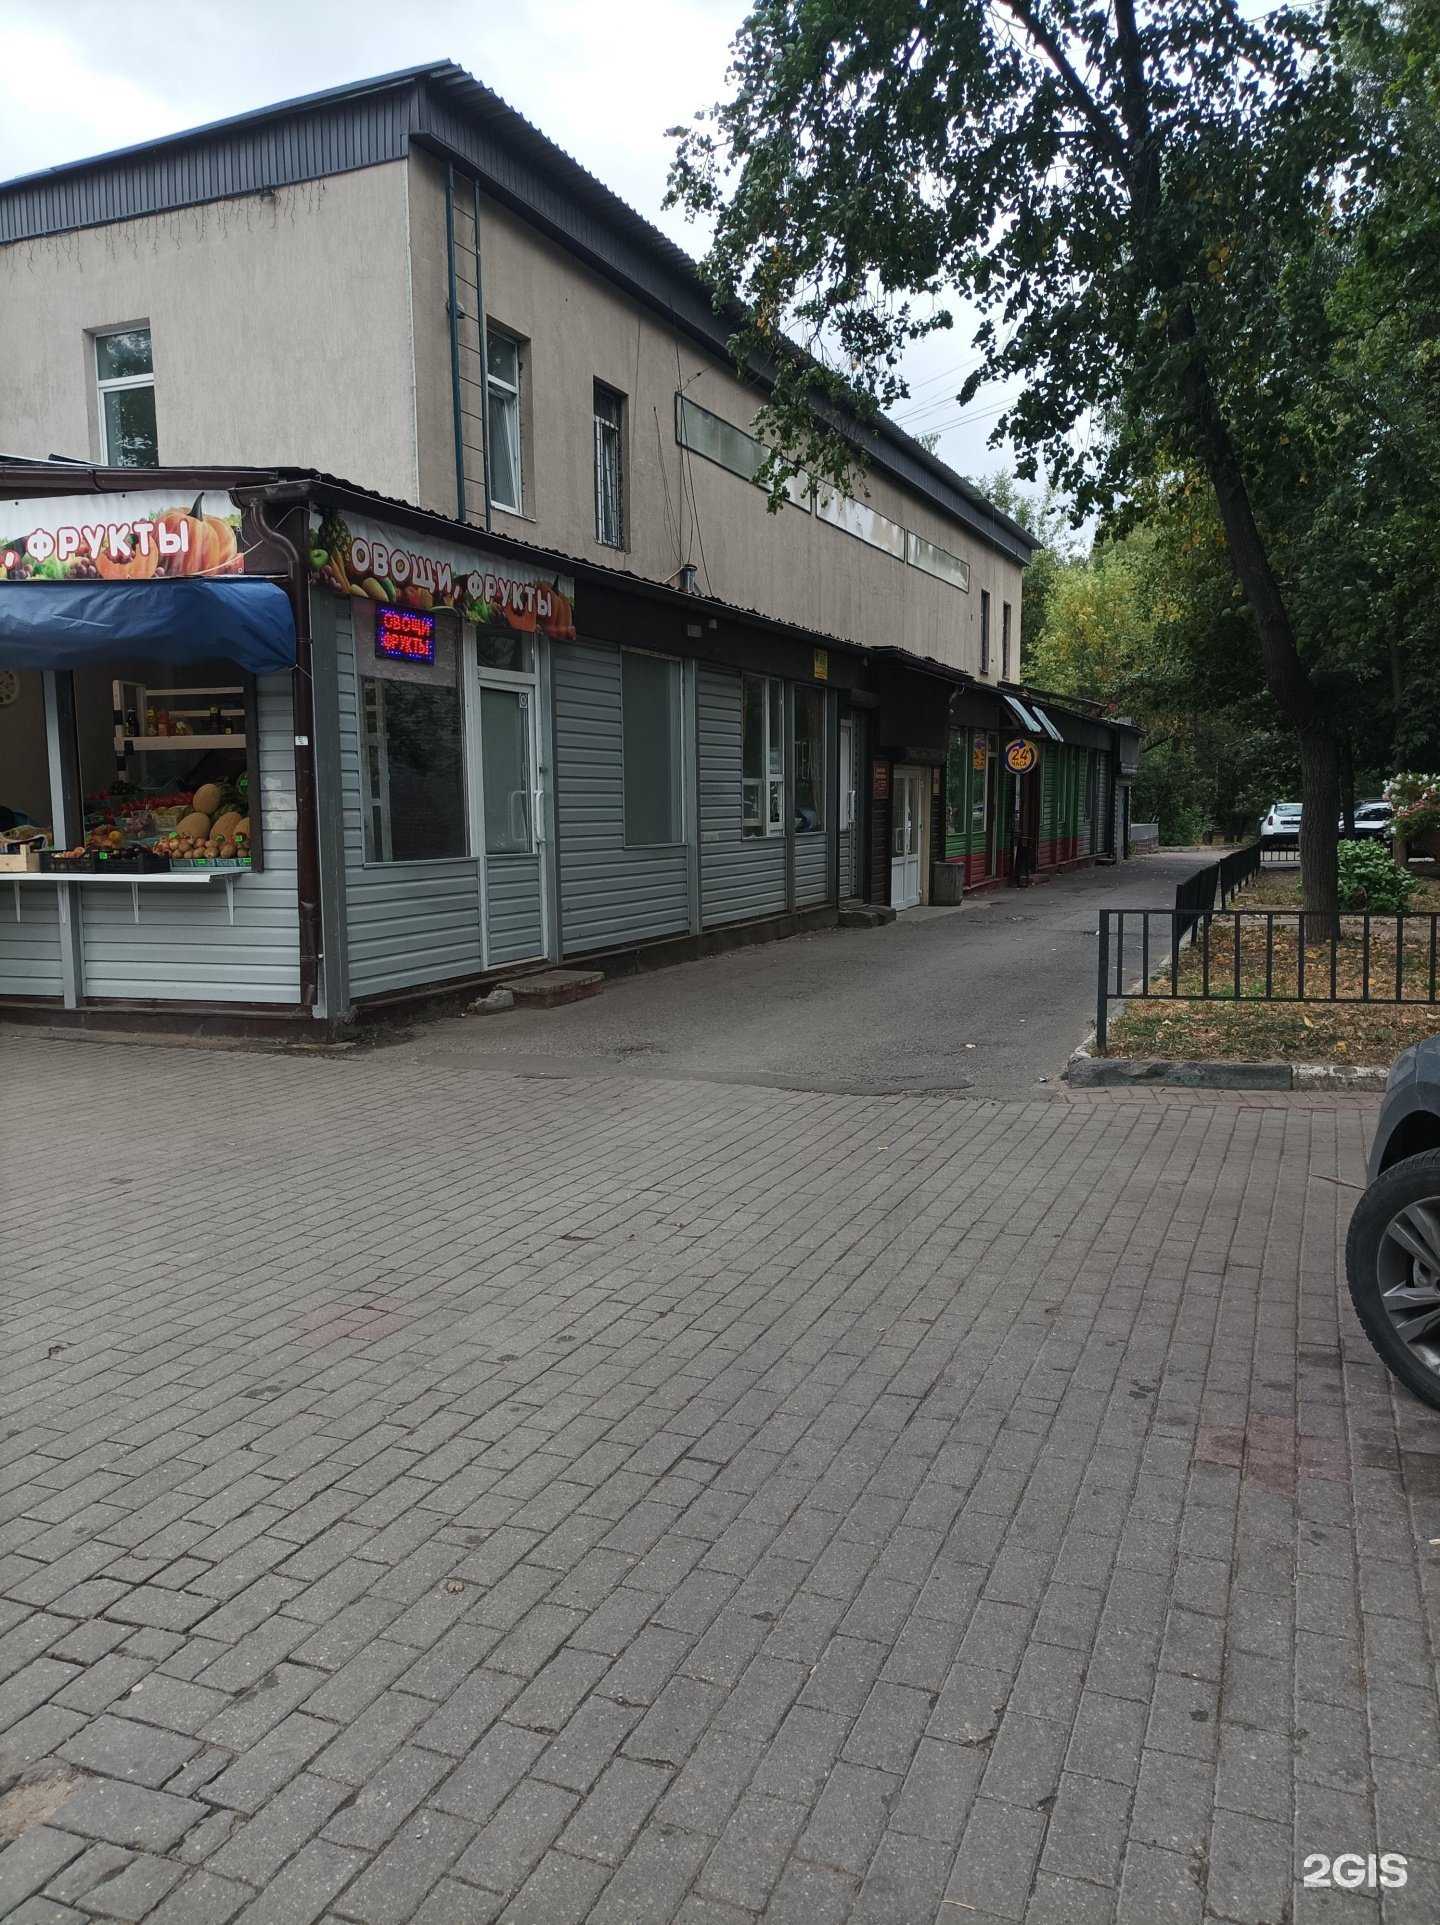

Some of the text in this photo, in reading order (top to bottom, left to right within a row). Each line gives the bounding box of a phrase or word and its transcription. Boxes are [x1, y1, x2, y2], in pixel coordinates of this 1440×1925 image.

[26, 518, 190, 563] ФРУКТЫ
[351, 537, 552, 617] ОВОЩИ, ФРУКТЫ
[383, 613, 430, 637] ОВОЩИ
[383, 631, 430, 655] ФРУКТЫ
[1011, 748, 1028, 761] 24
